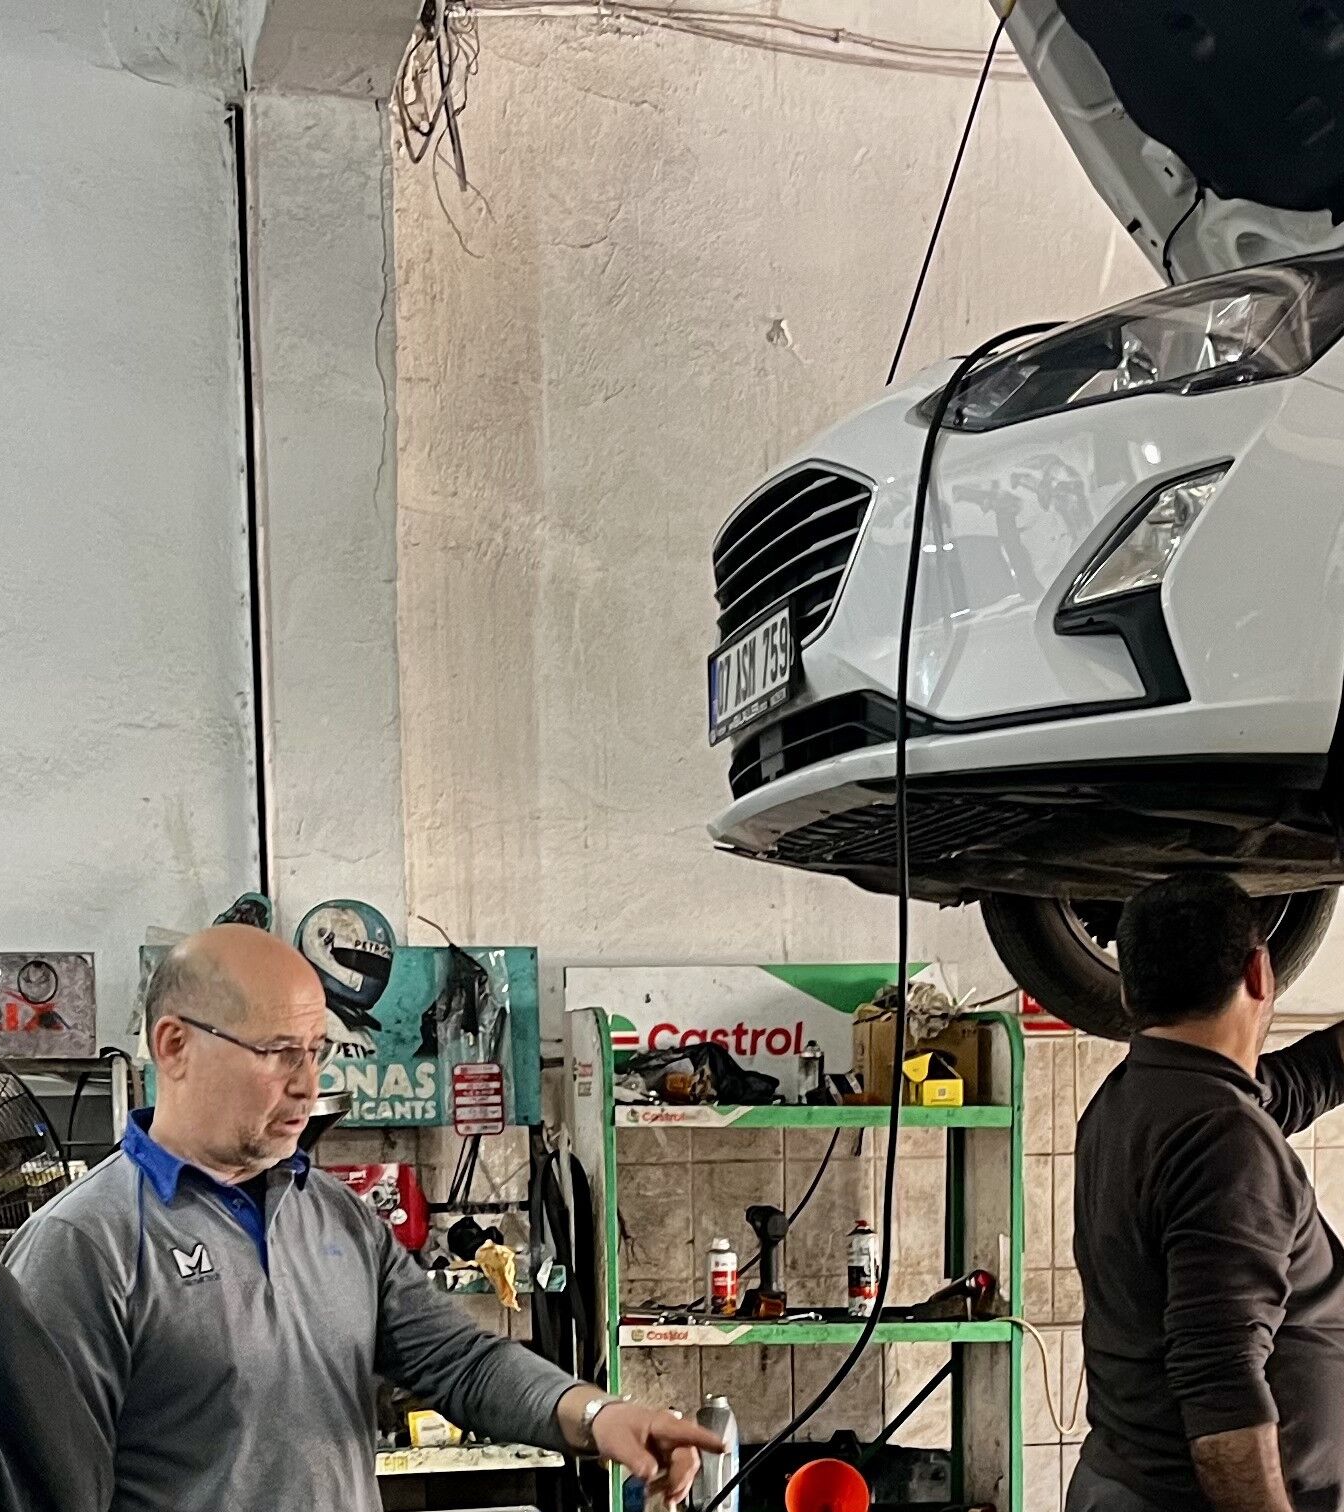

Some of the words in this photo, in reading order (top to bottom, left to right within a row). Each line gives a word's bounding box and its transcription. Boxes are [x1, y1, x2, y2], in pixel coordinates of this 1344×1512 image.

[762, 616, 788, 689] 759
[647, 1021, 804, 1056] Castrol
[344, 1101, 437, 1119] ICANTS
